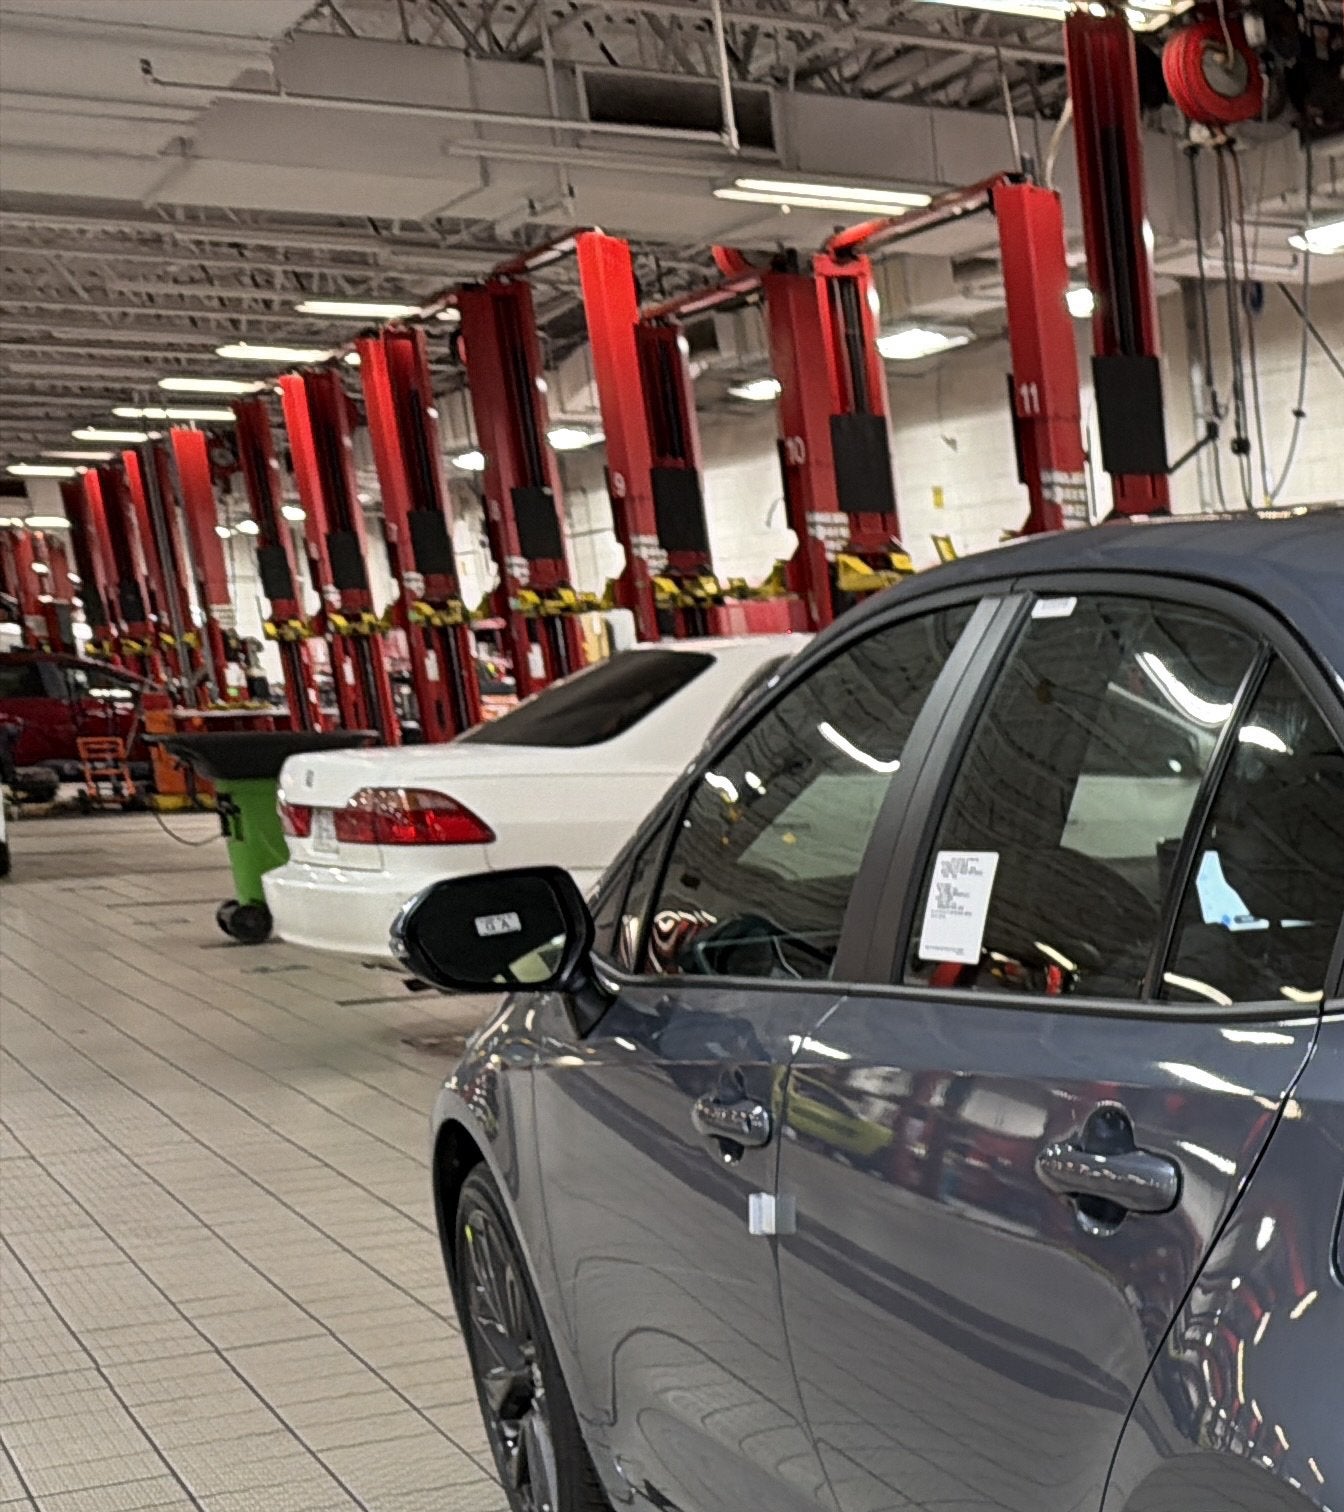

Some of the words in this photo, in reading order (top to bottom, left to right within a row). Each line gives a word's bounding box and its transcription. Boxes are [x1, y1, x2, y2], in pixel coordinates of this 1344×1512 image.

[1020, 382, 1040, 414] 11
[785, 436, 806, 465] 10
[612, 471, 626, 498] 9
